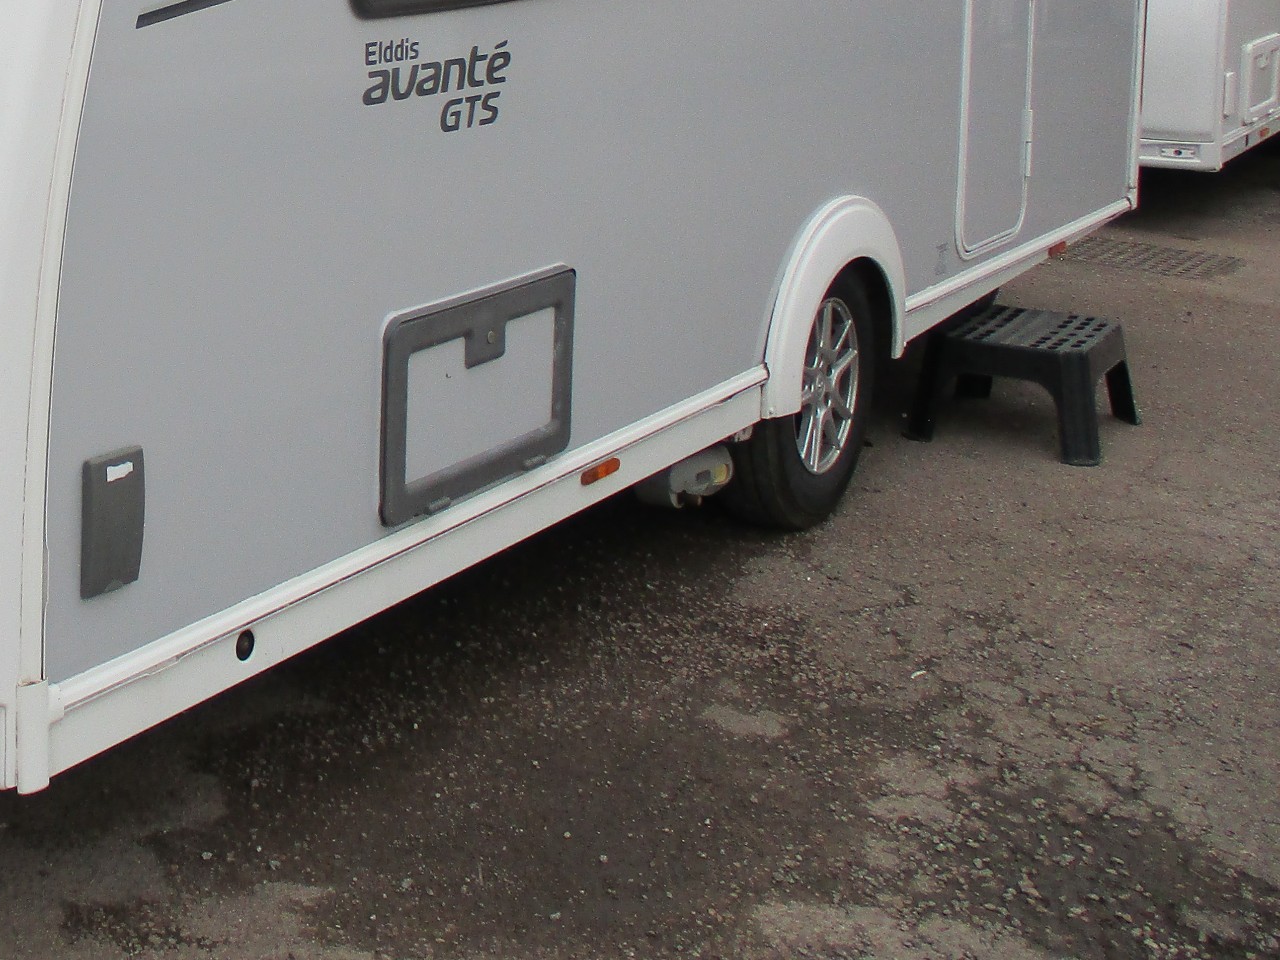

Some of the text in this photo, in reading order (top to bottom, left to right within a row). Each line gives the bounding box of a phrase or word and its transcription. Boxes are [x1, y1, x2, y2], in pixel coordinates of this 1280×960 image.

[362, 40, 511, 106] avanté
[365, 38, 419, 66] Elddis
[440, 91, 501, 133] GTS
